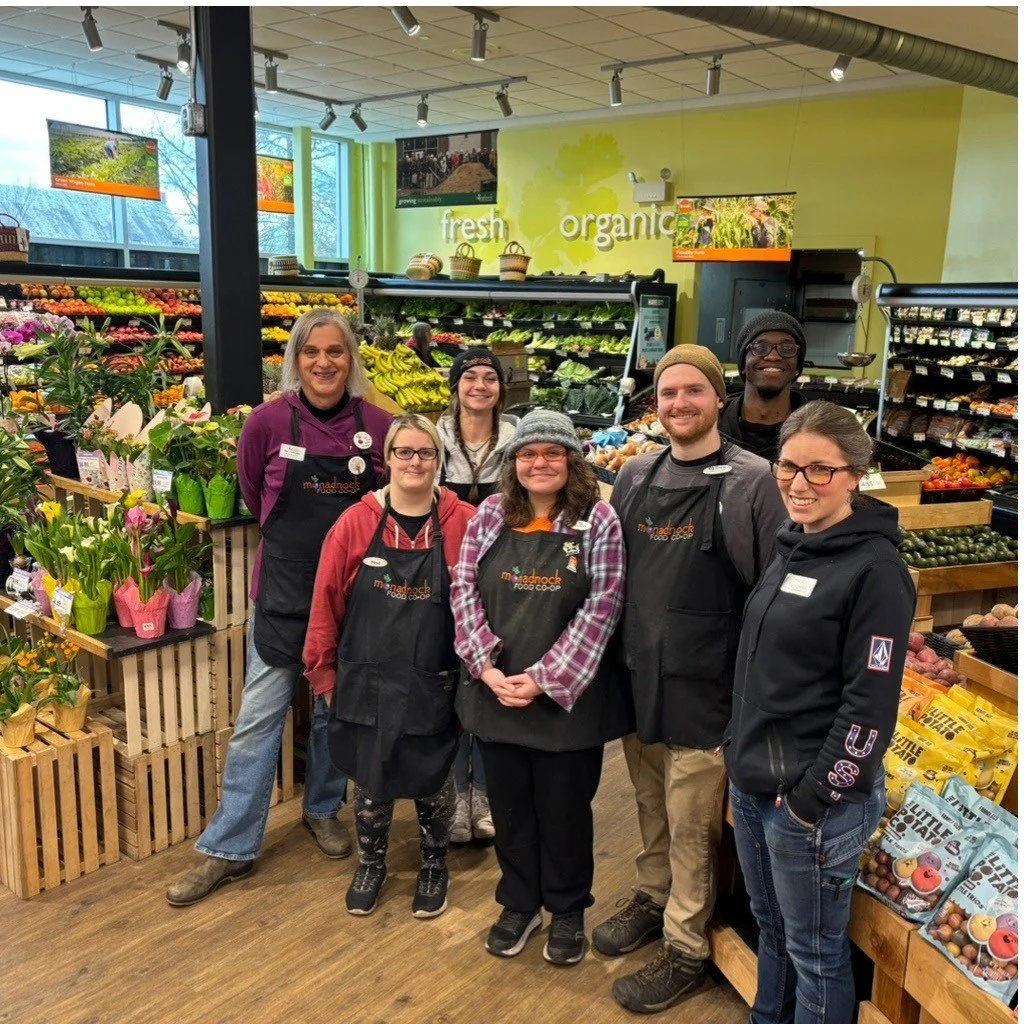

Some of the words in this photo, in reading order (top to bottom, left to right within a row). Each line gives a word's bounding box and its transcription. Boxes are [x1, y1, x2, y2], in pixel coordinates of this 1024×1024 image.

[440, 208, 505, 241] fresh
[560, 204, 676, 248] organic
[638, 518, 697, 535] monadnock
[671, 533, 693, 541] CO-OP
[501, 568, 563, 585] monadnock
[374, 579, 431, 594] monadnock
[513, 583, 534, 591] FOOD
[535, 584, 561, 592] CO-OP
[387, 590, 407, 600] FOOD
[408, 593, 431, 601] CO-OP
[920, 714, 955, 741] POTATO
[891, 745, 917, 766] TATO
[897, 808, 942, 846] POTATO
